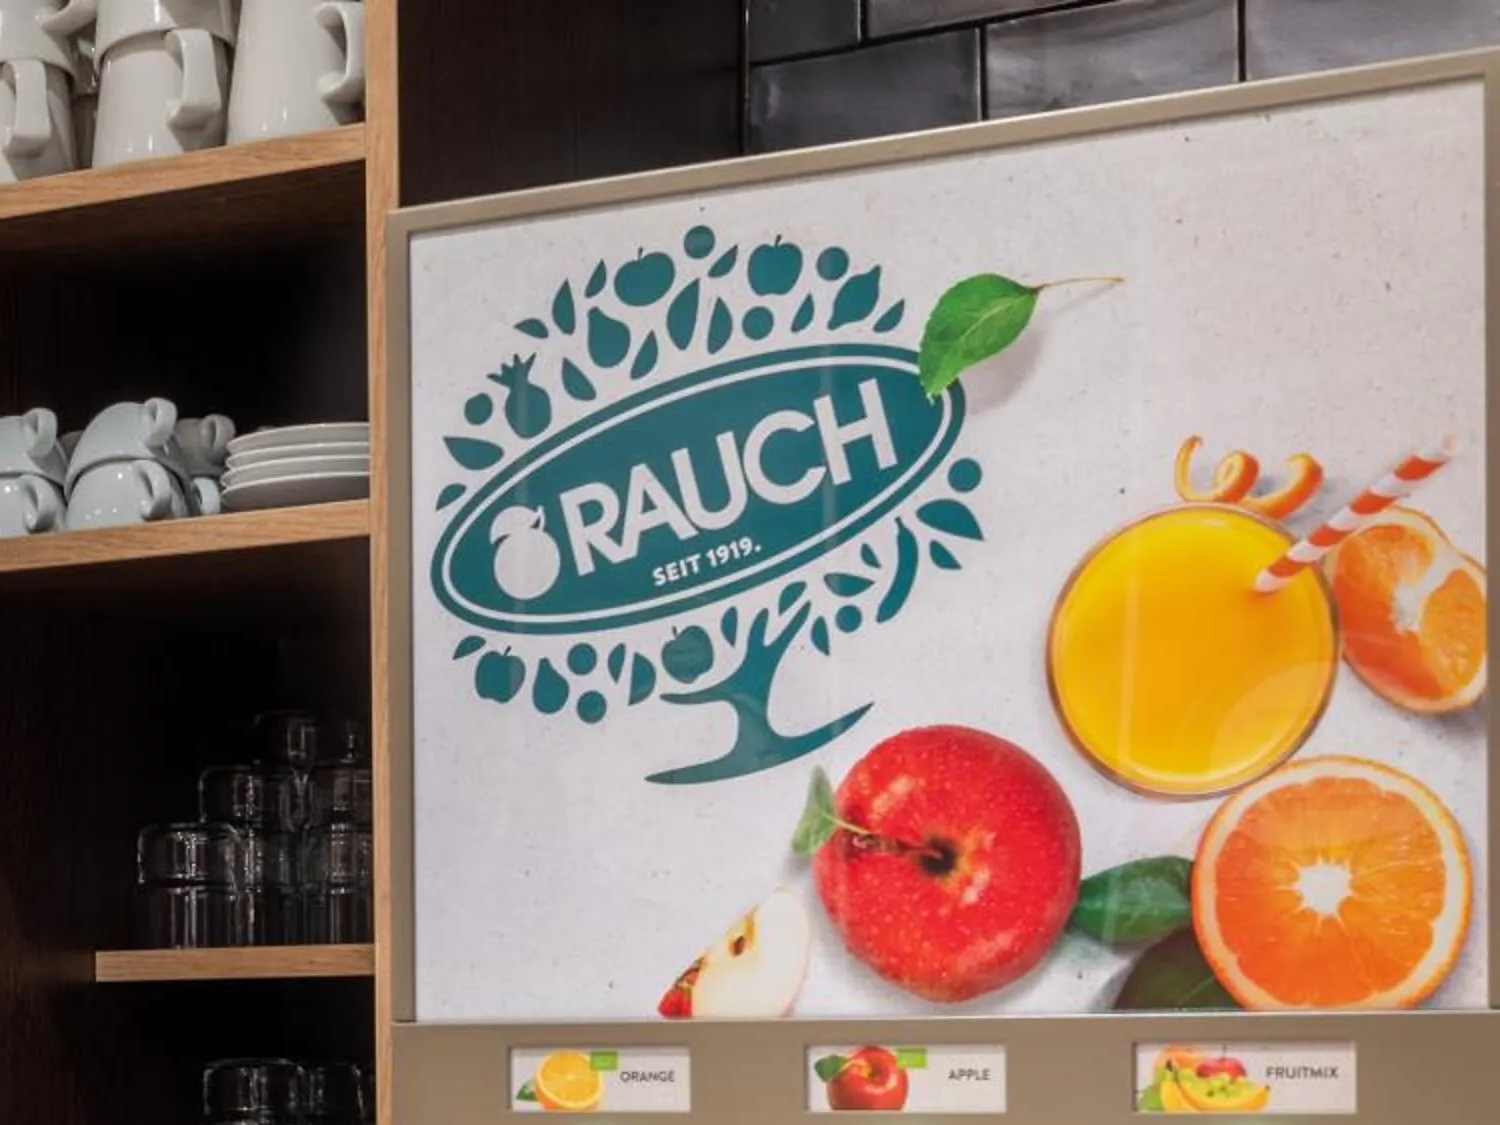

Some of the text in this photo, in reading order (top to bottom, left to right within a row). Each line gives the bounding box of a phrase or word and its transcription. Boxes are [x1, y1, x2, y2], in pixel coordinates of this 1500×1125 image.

[560, 378, 898, 577] RAUCH
[652, 536, 762, 586] SEIT 1919.
[620, 1070, 674, 1083] ORANGE
[948, 1068, 990, 1081] APPLE
[1266, 1066, 1338, 1079] FRUITMIX
